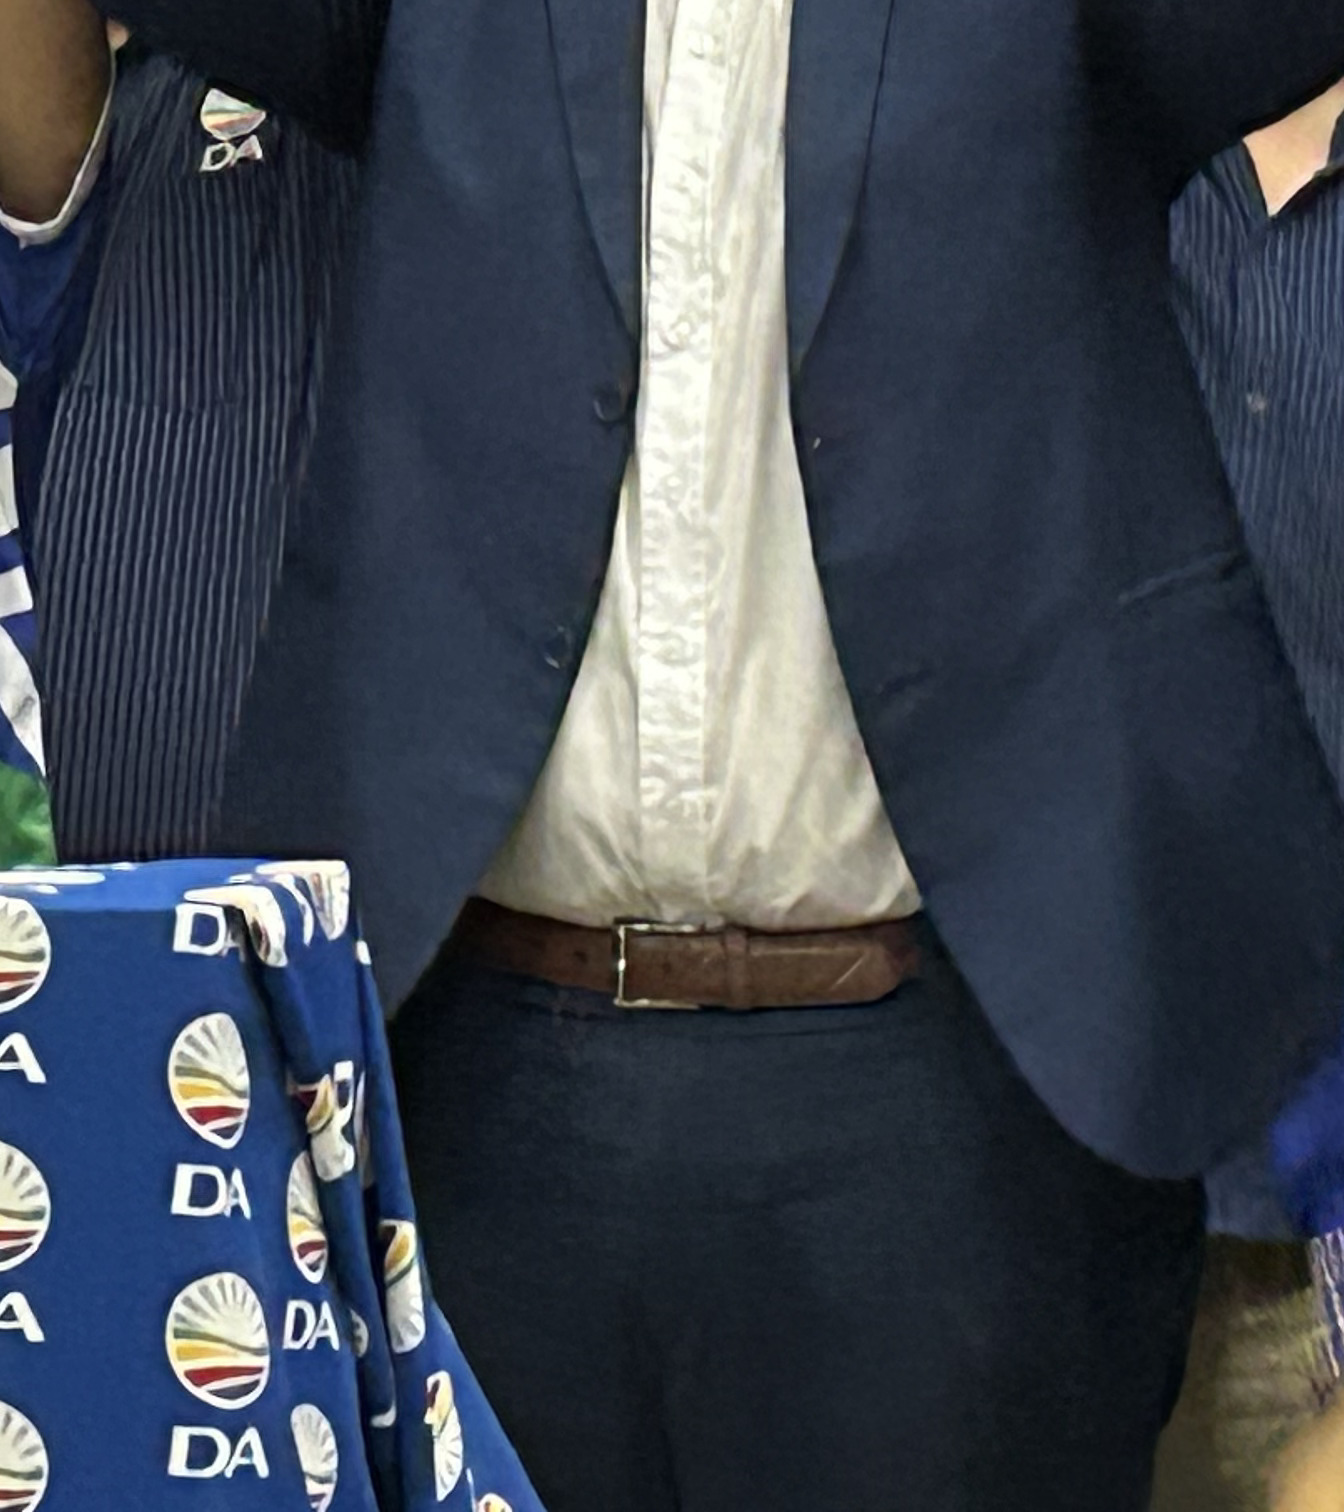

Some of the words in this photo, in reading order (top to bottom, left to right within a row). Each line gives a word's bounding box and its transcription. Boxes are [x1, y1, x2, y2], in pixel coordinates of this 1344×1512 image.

[170, 1163, 252, 1220] DA
[282, 1299, 340, 1351] DA
[168, 1425, 269, 1479] DA
